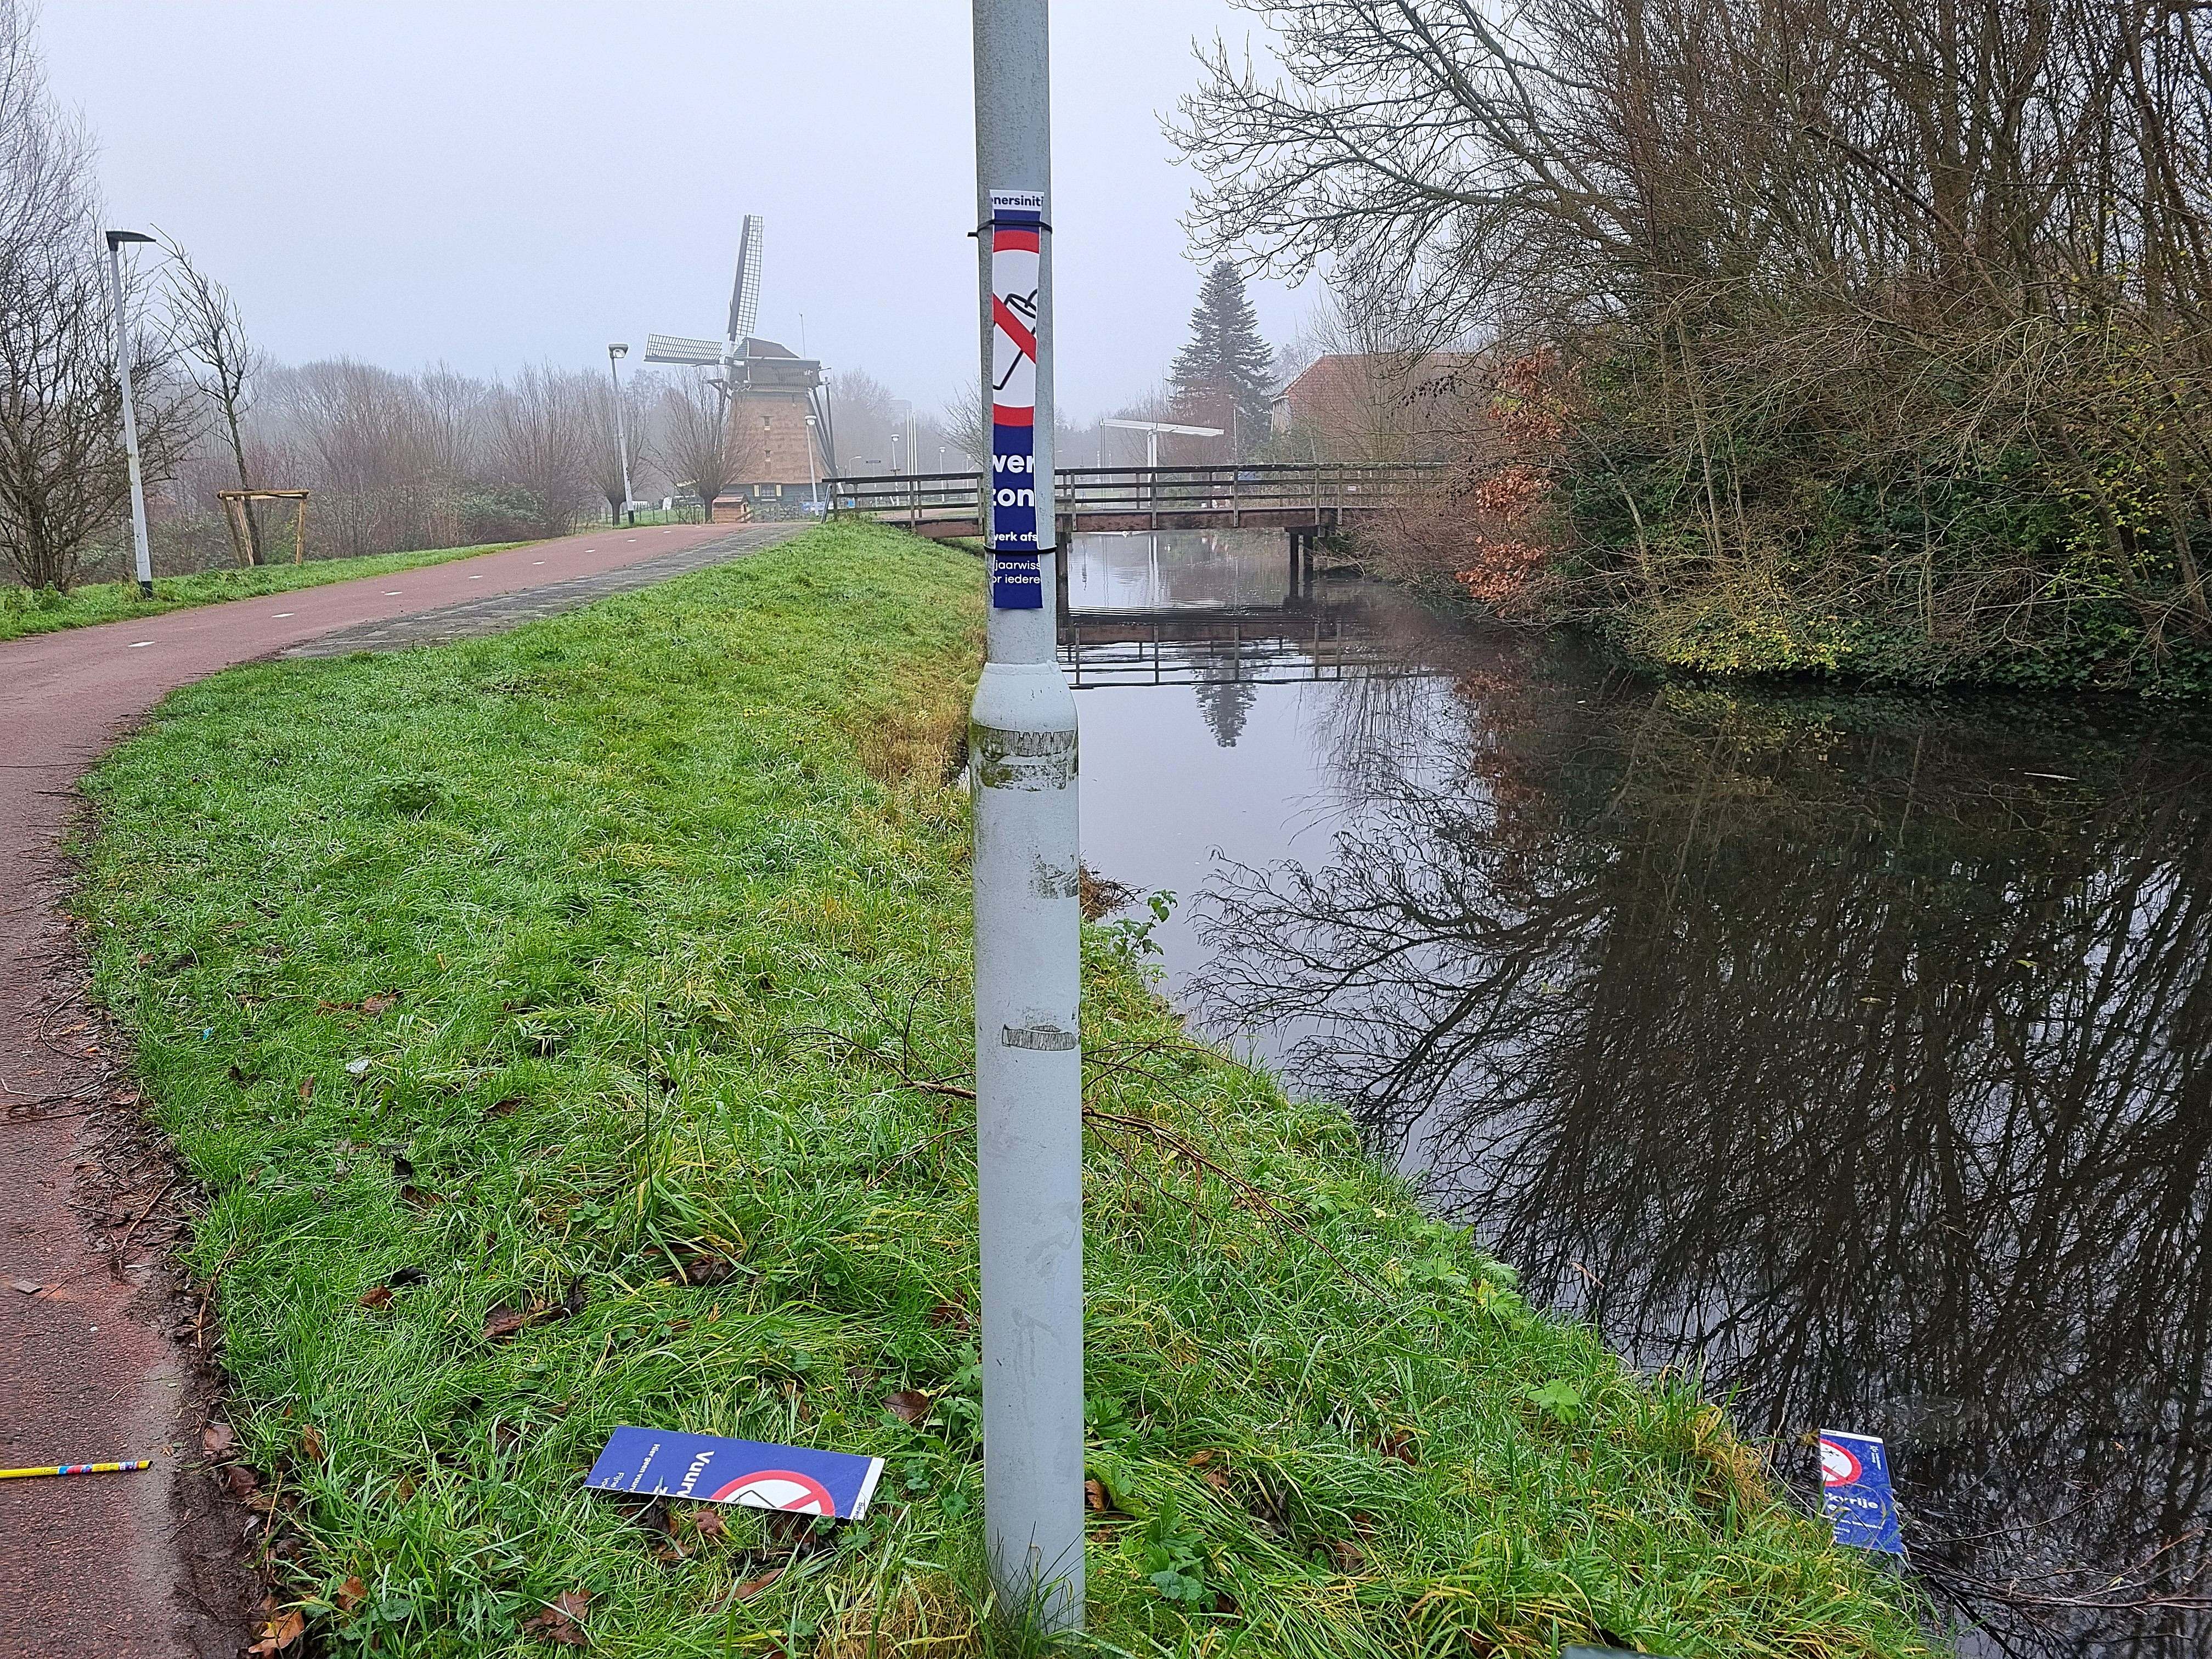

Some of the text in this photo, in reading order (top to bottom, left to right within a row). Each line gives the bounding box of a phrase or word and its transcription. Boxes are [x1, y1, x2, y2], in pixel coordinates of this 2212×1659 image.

[992, 195, 1043, 206] nersiniti
[992, 488, 1035, 507] on
[1005, 574, 1040, 584] iedere
[649, 1443, 661, 1458] Hier
